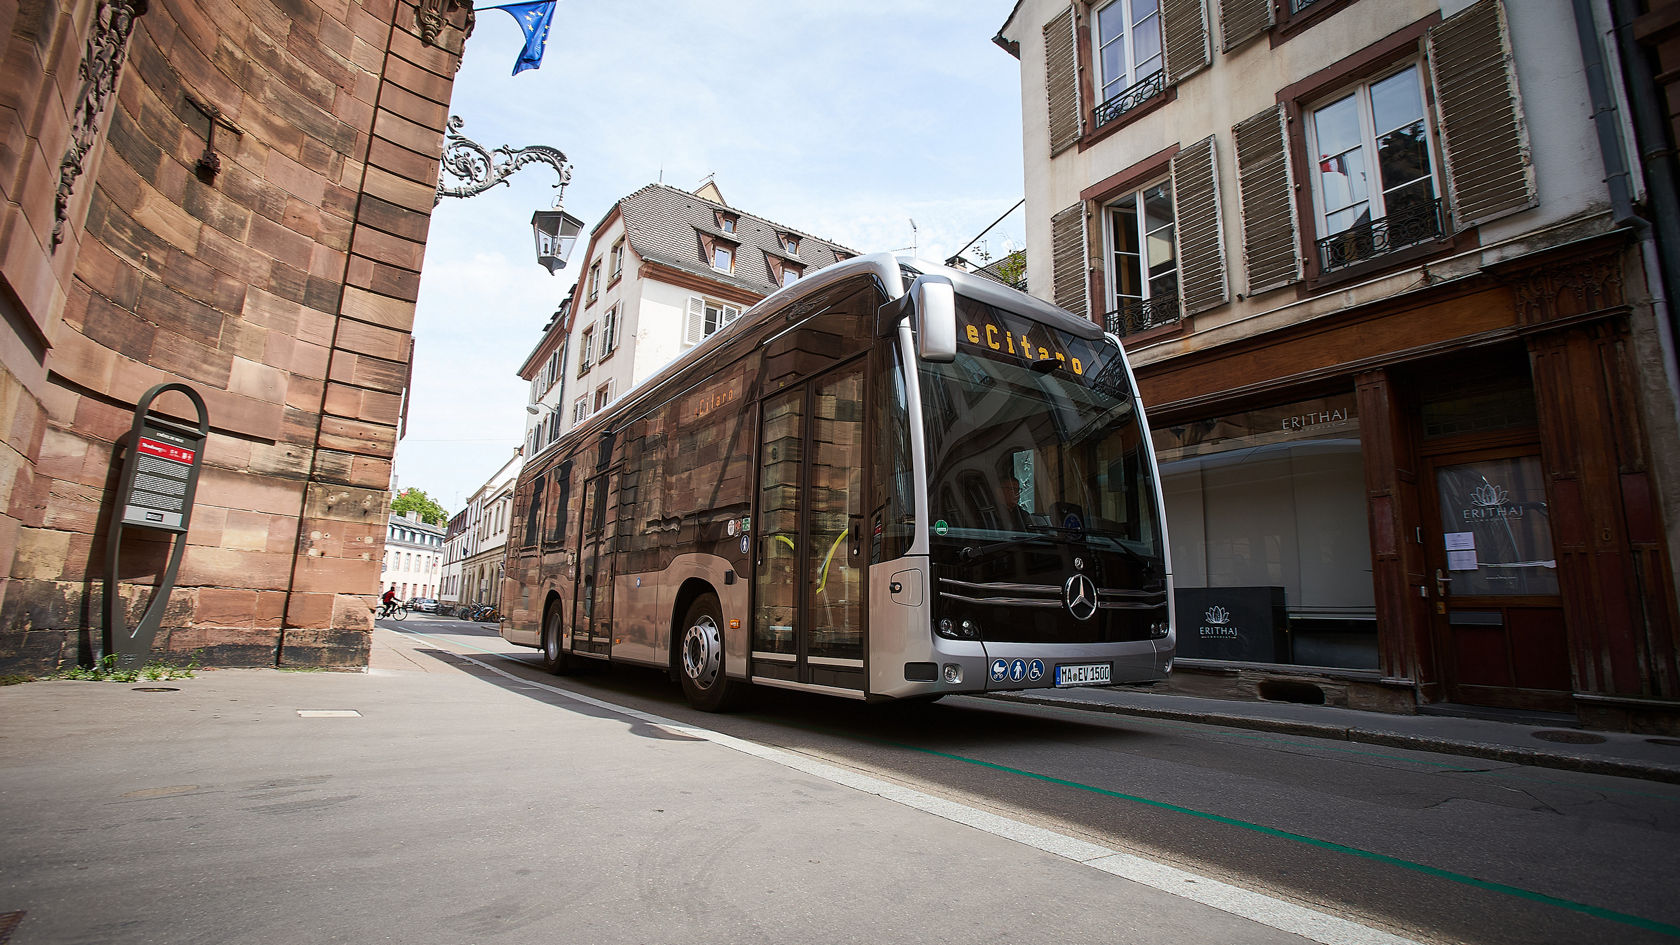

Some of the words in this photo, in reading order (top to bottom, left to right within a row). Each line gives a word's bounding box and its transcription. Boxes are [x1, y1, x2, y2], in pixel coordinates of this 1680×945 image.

[1282, 407, 1348, 430] ERITHAJ
[1463, 505, 1524, 519] ERITHAJ
[1199, 626, 1238, 637] ERITHAJ
[1061, 667, 1073, 683] MA
[1078, 667, 1089, 682] EV
[1090, 666, 1110, 681] 1500
